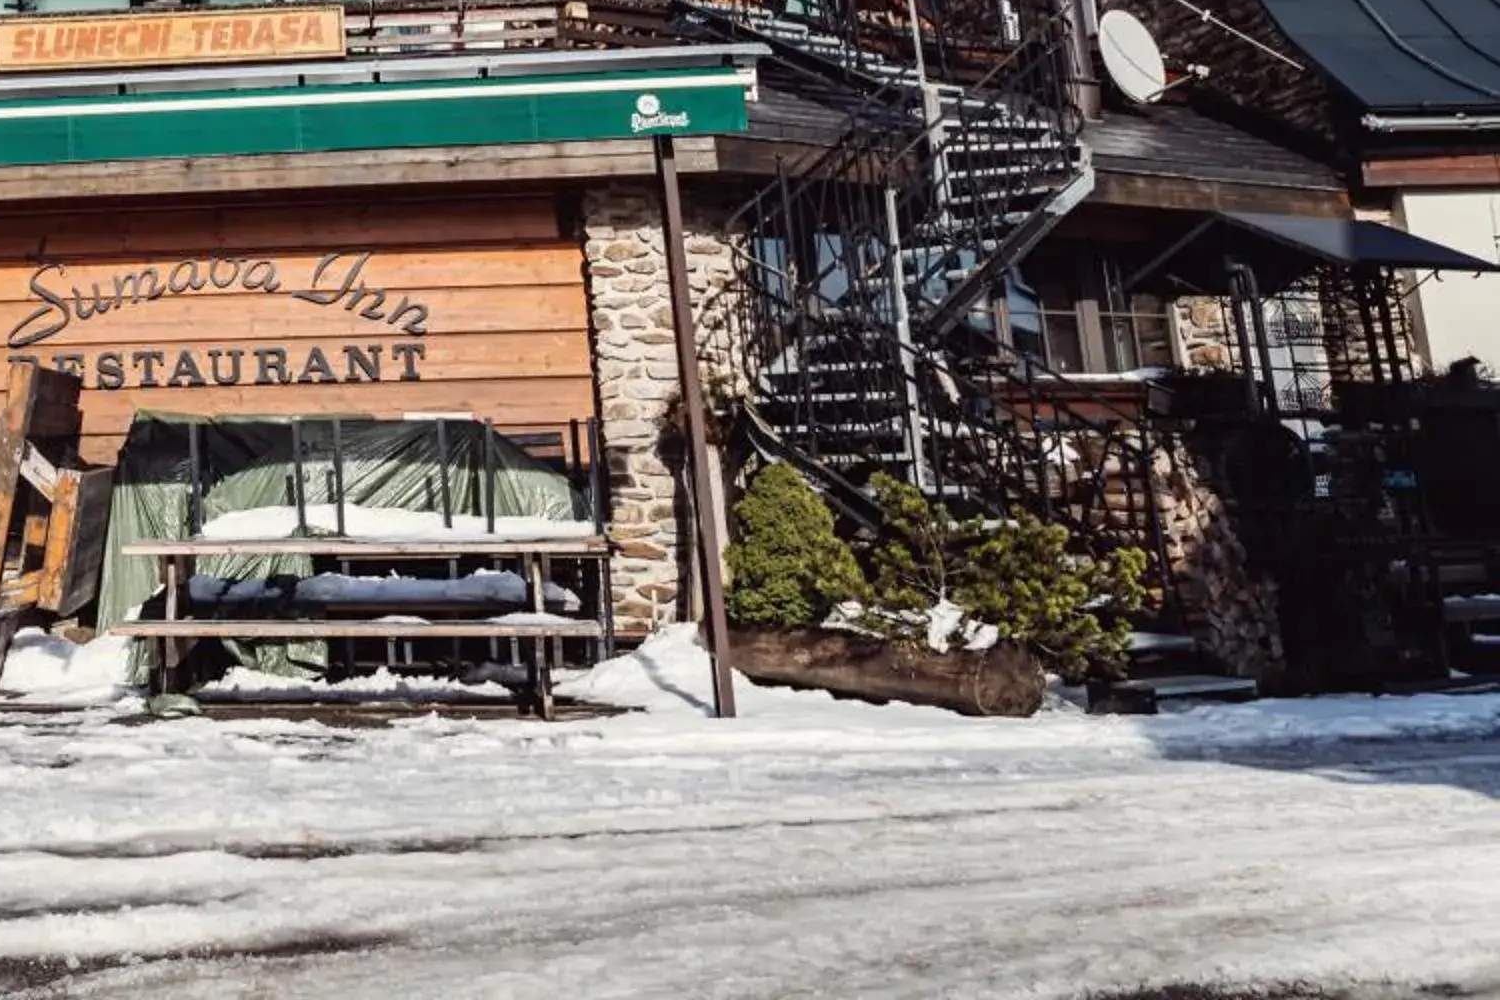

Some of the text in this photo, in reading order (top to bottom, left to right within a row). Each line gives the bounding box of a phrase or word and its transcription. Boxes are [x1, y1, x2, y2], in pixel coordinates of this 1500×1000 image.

[191, 14, 325, 53] TERASA
[291, 249, 430, 336] Inn
[7, 343, 426, 391] ESTAURANT
